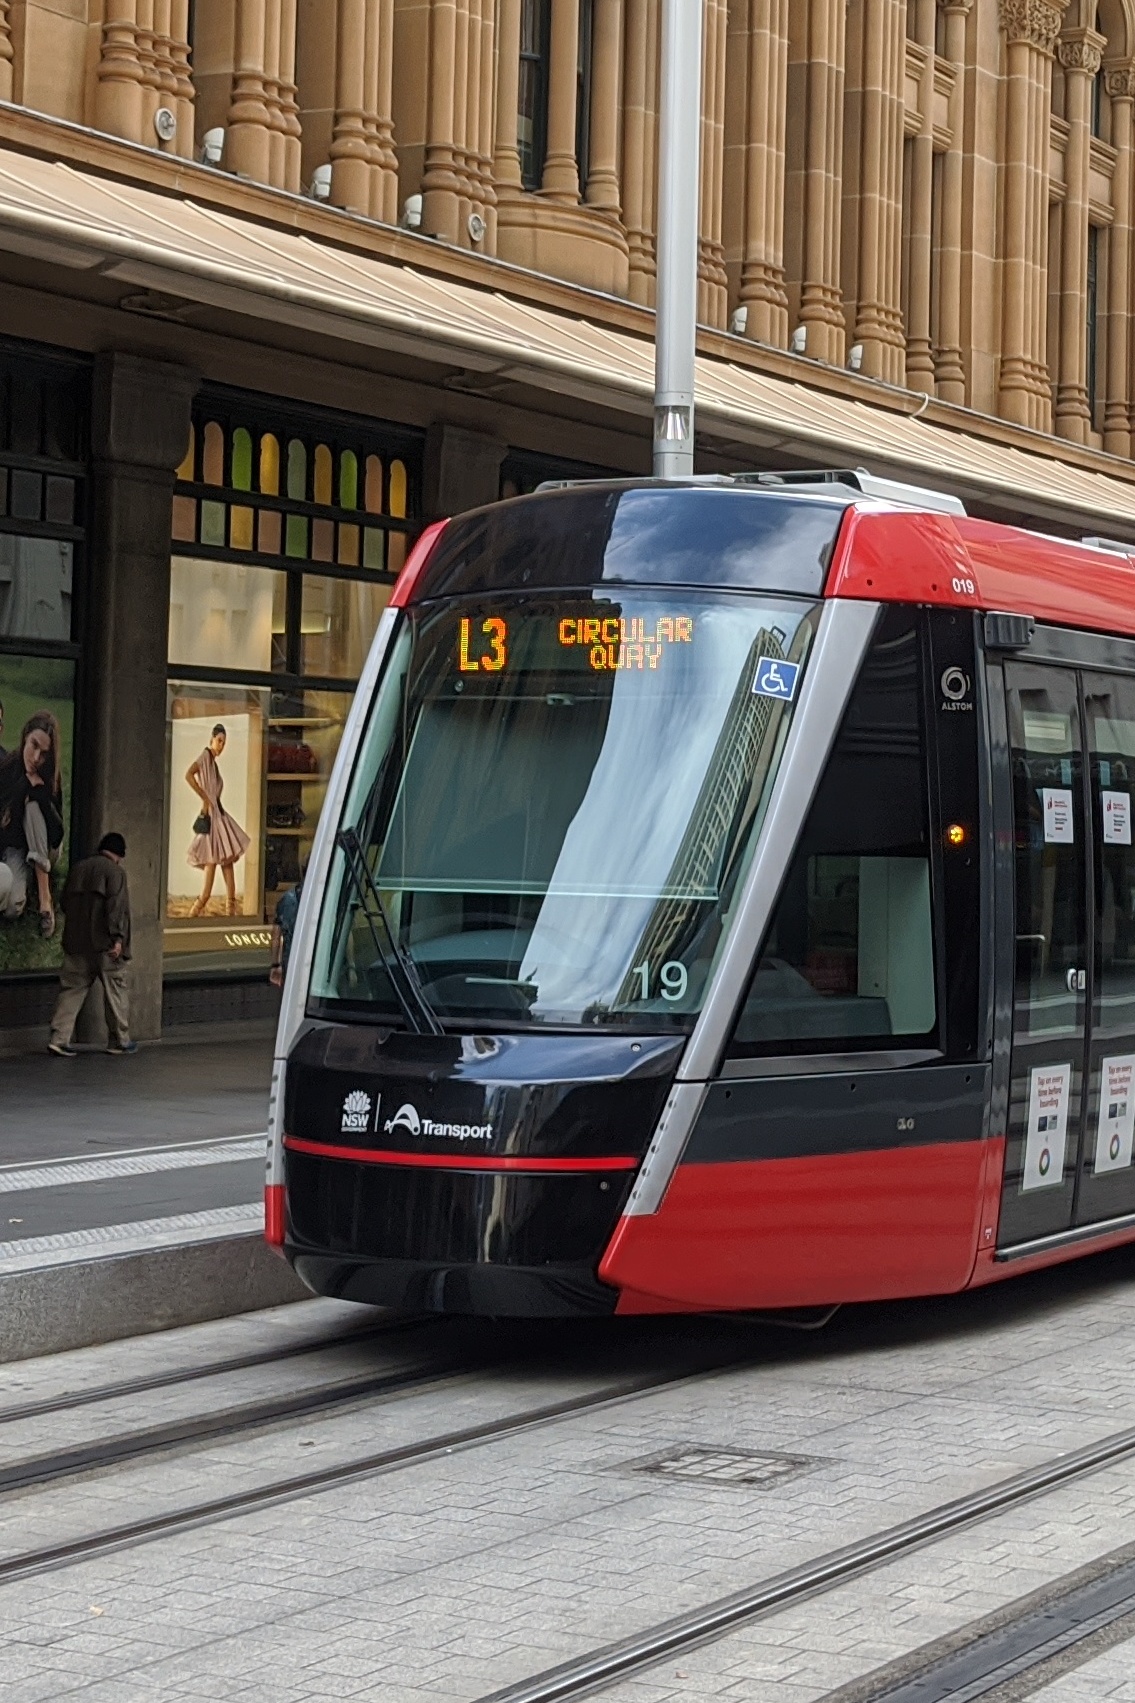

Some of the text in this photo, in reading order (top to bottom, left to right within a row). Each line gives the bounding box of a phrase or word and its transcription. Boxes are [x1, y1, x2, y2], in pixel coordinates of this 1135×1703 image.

[952, 577, 975, 594] 019
[559, 616, 694, 644] CIRCULAR
[459, 617, 507, 671] L3
[589, 643, 663, 670] QUAY
[941, 702, 973, 711] ALSTOM
[224, 932, 272, 946] LONGC
[632, 960, 688, 1001] 19
[341, 1113, 370, 1127] NSW
[421, 1118, 494, 1141] Transport
